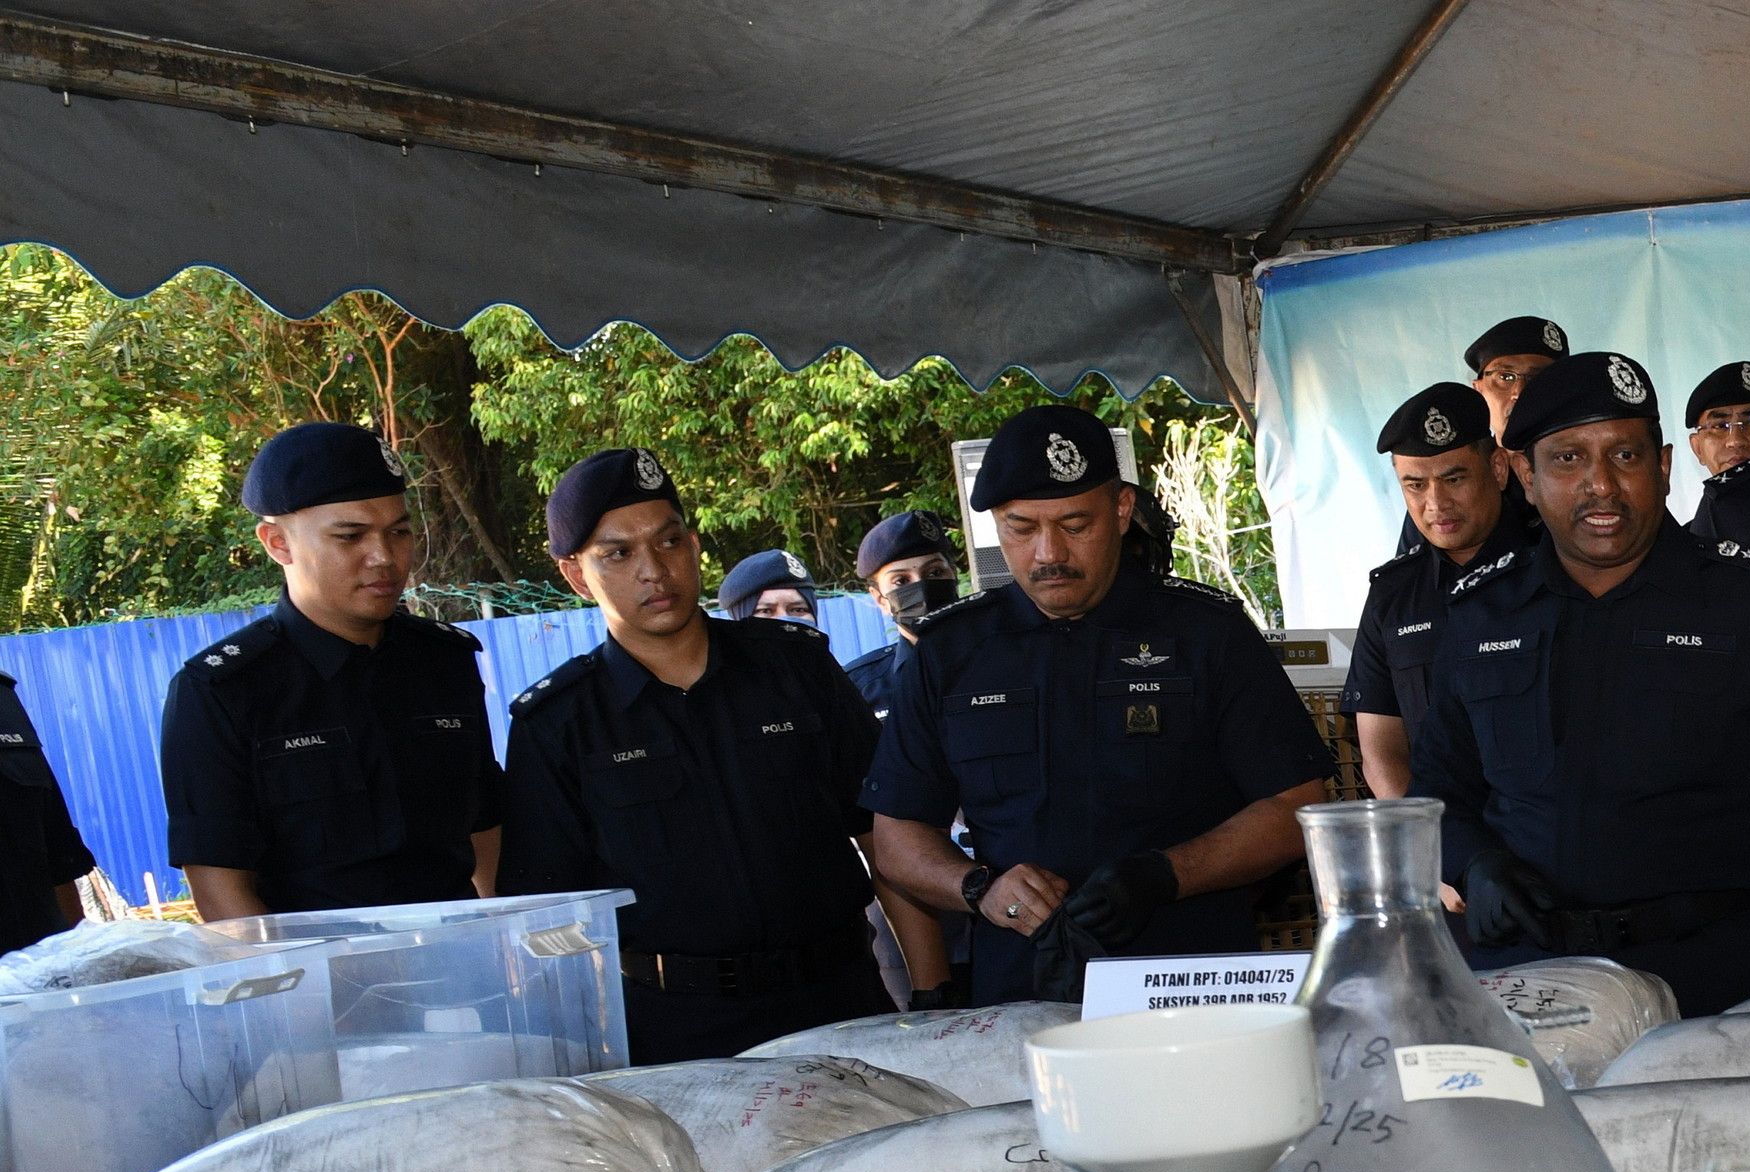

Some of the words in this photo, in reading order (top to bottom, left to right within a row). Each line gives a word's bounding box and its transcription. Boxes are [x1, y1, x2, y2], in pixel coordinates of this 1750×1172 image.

[1397, 621, 1432, 636] SARUDIN
[1478, 639, 1522, 653] HUSSEIN
[1665, 634, 1703, 646] POLIS
[1129, 683, 1161, 692] POLIS
[970, 694, 1006, 706] AZIZEE
[435, 719, 462, 729] POLIS
[761, 722, 795, 734] POLIS
[284, 735, 327, 749] AKMAL
[612, 749, 647, 762] UZAIRI
[1144, 971, 1190, 988] PATANI
[1193, 971, 1221, 986] RPT:
[1224, 969, 1295, 985] 014047/25
[1148, 995, 1200, 1009] SEKSYEN
